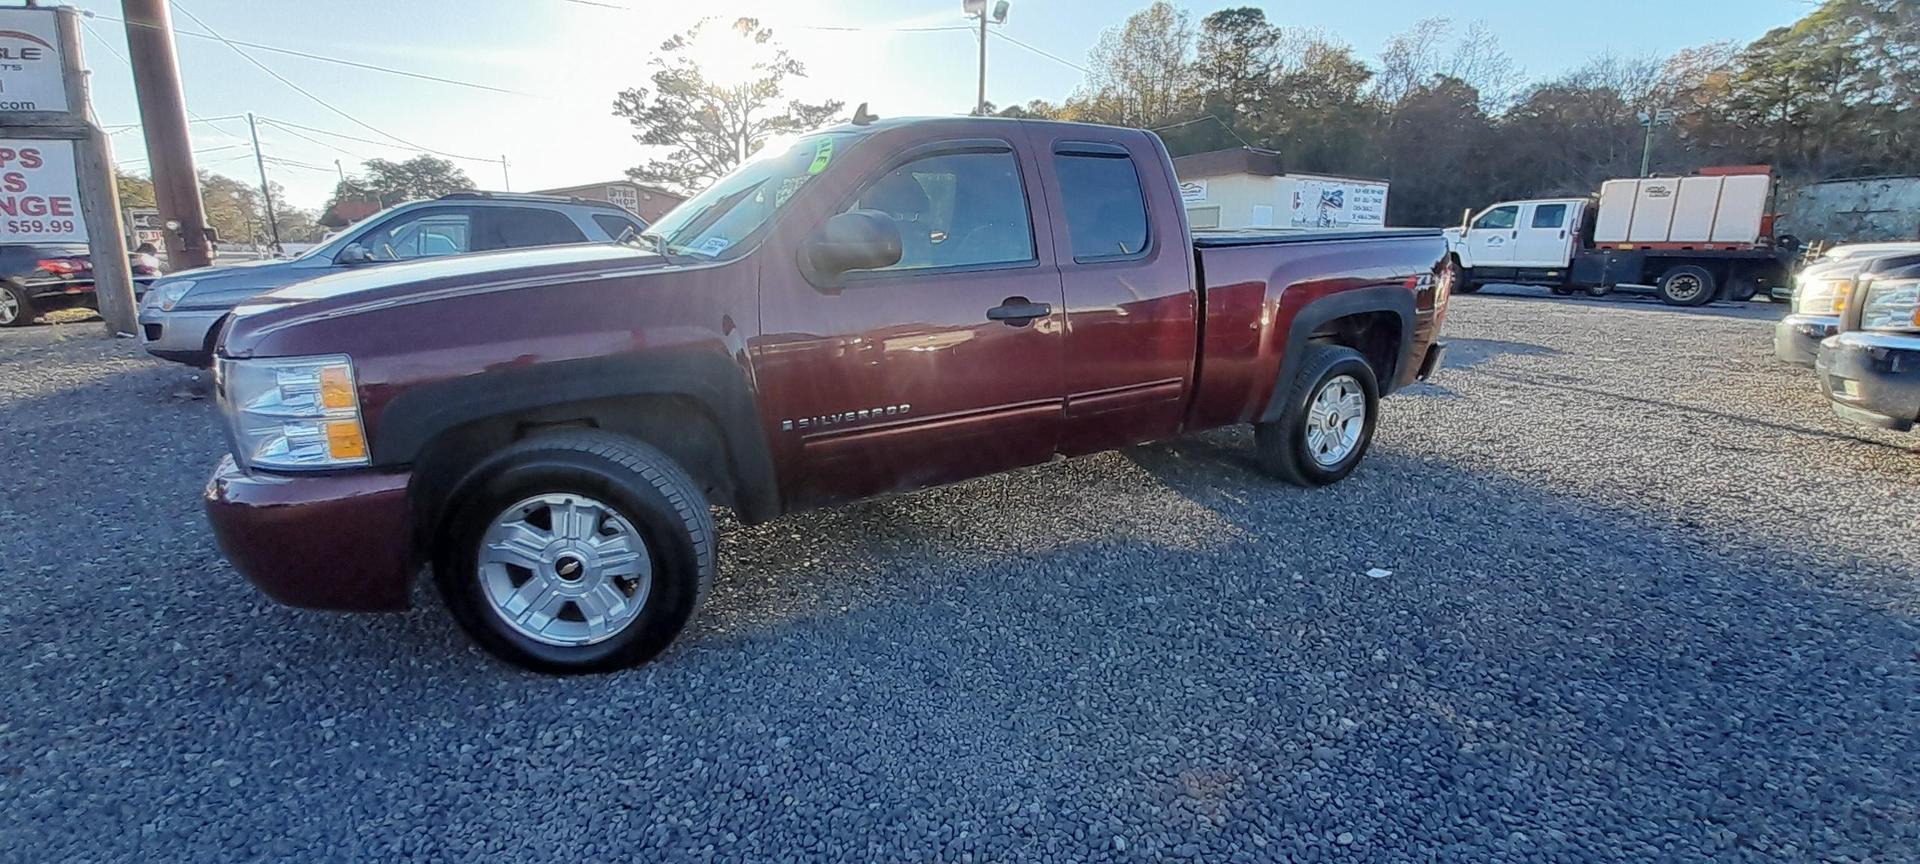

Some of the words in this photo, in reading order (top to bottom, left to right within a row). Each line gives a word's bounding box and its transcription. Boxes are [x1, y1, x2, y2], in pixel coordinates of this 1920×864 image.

[0, 47, 42, 60] LE
[0, 172, 28, 193] S
[7, 219, 74, 234] $59.99
[797, 403, 911, 429] SILVERADO
